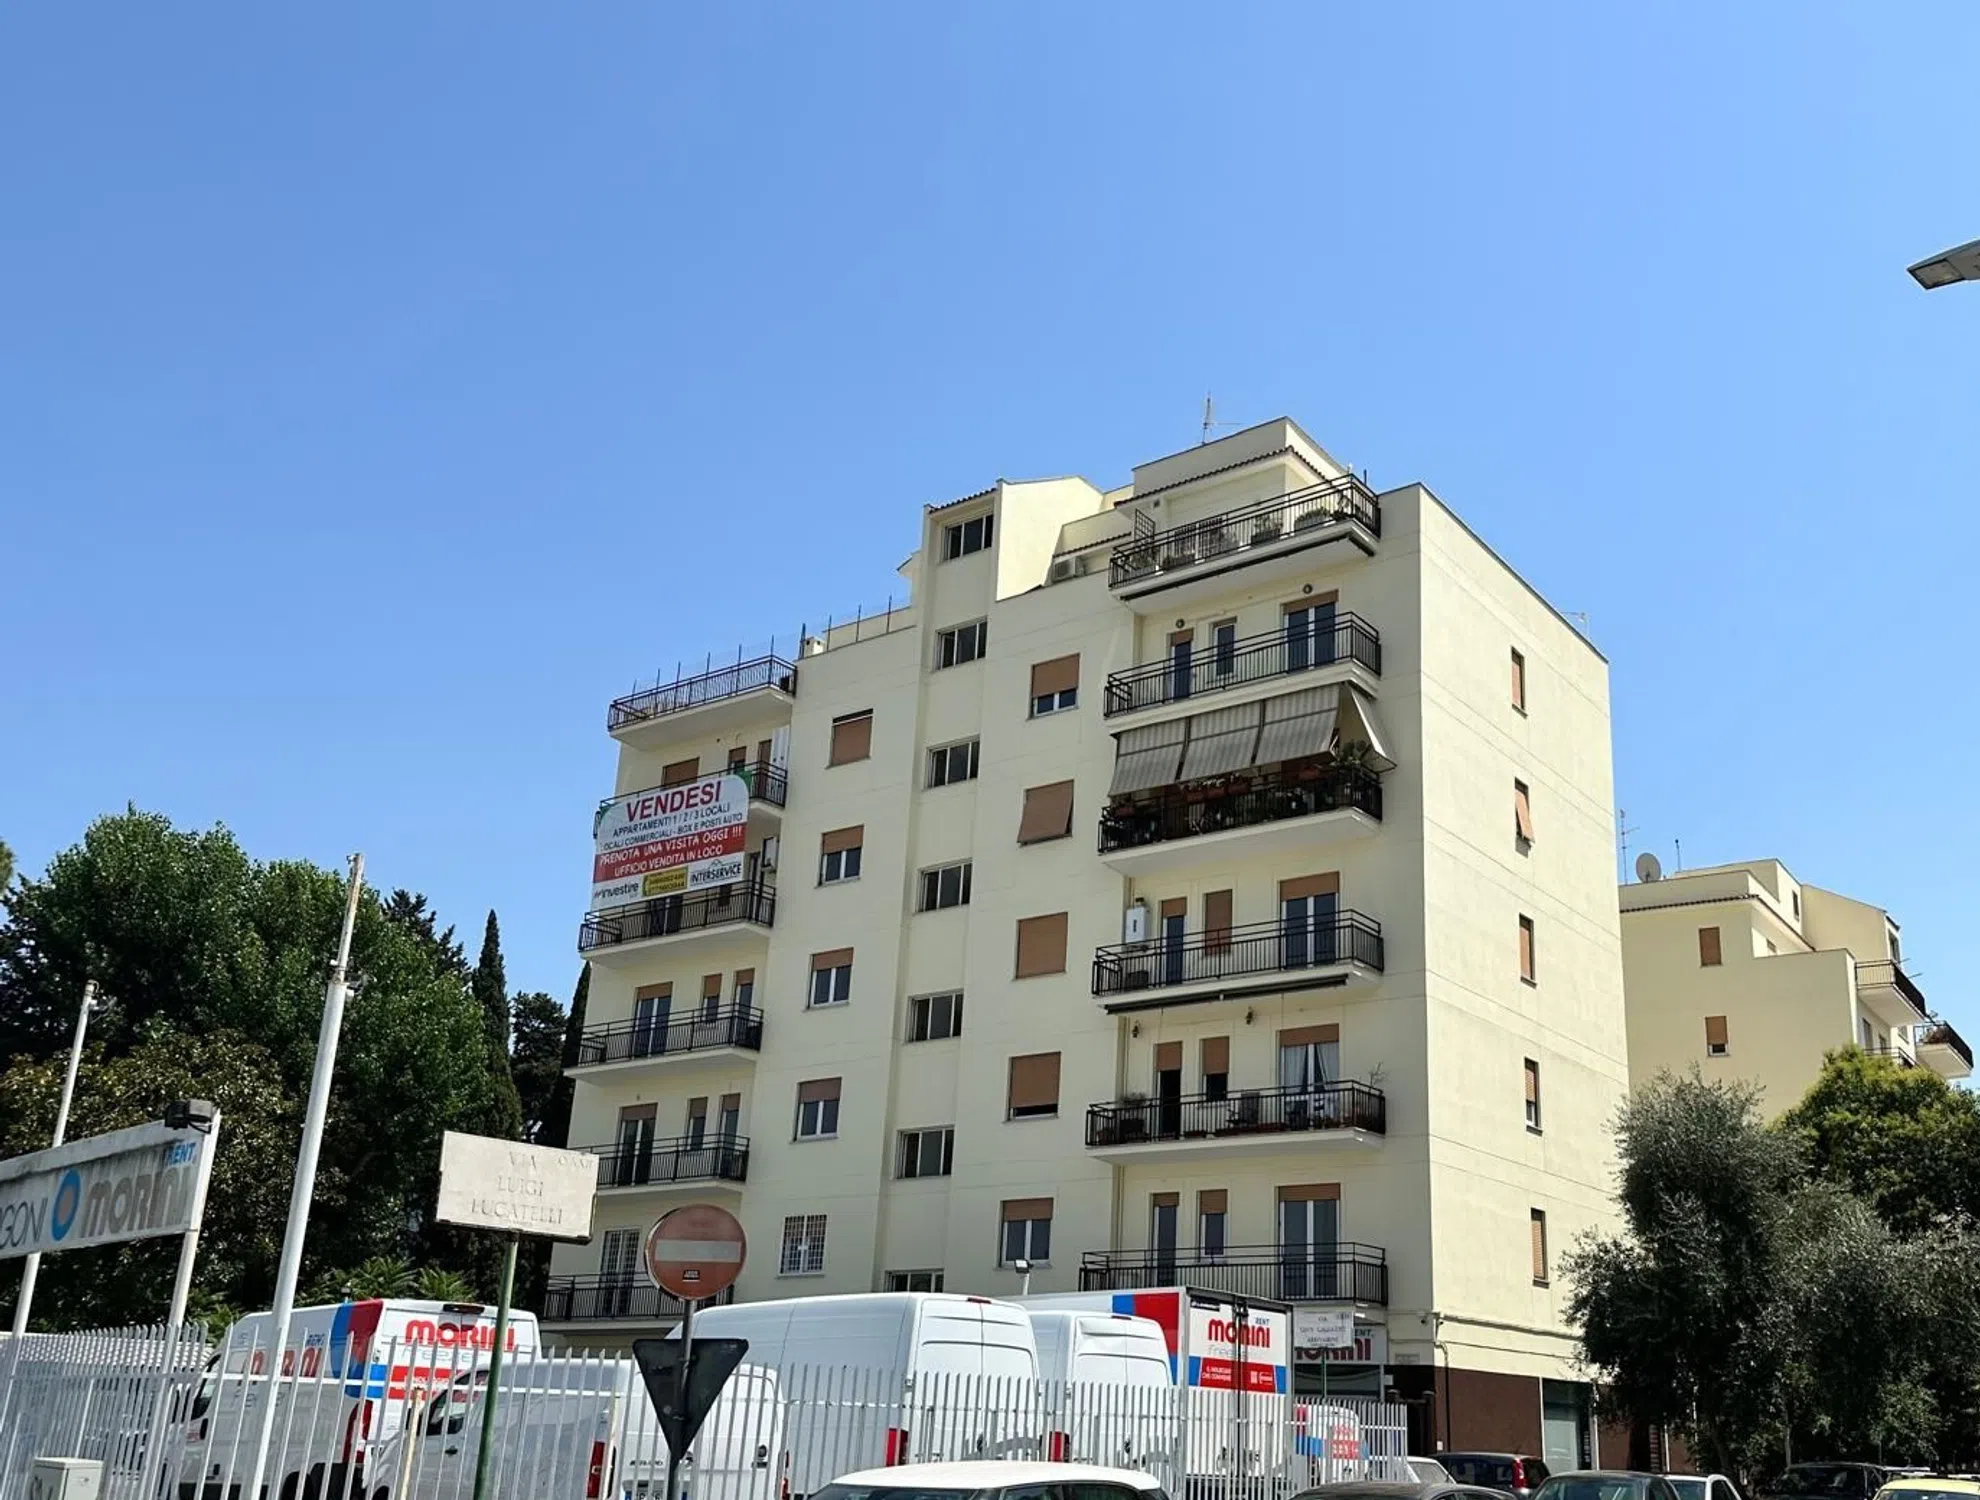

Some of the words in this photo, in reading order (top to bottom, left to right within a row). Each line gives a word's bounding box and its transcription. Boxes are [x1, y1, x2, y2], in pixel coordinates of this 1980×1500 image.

[626, 780, 722, 822] VENDESI
[612, 813, 671, 838] APPARTAMENTI
[700, 803, 730, 818] LOCALI
[600, 848, 641, 867] PRENOTA
[644, 842, 663, 857] UNA
[665, 835, 699, 852] VISITA
[702, 828, 729, 844] OGGI
[624, 831, 672, 847] COMMERCIALI
[614, 860, 648, 877] UFFICIO
[648, 853, 685, 869] VENDITA
[686, 851, 696, 862] IN
[697, 846, 723, 860] LOCO
[690, 862, 742, 883] INTERSERVICE
[509, 1151, 537, 1168] VIA
[497, 1174, 545, 1197] LUIGI
[471, 1198, 563, 1225] LUCATELLI
[404, 1319, 516, 1352] MORII
